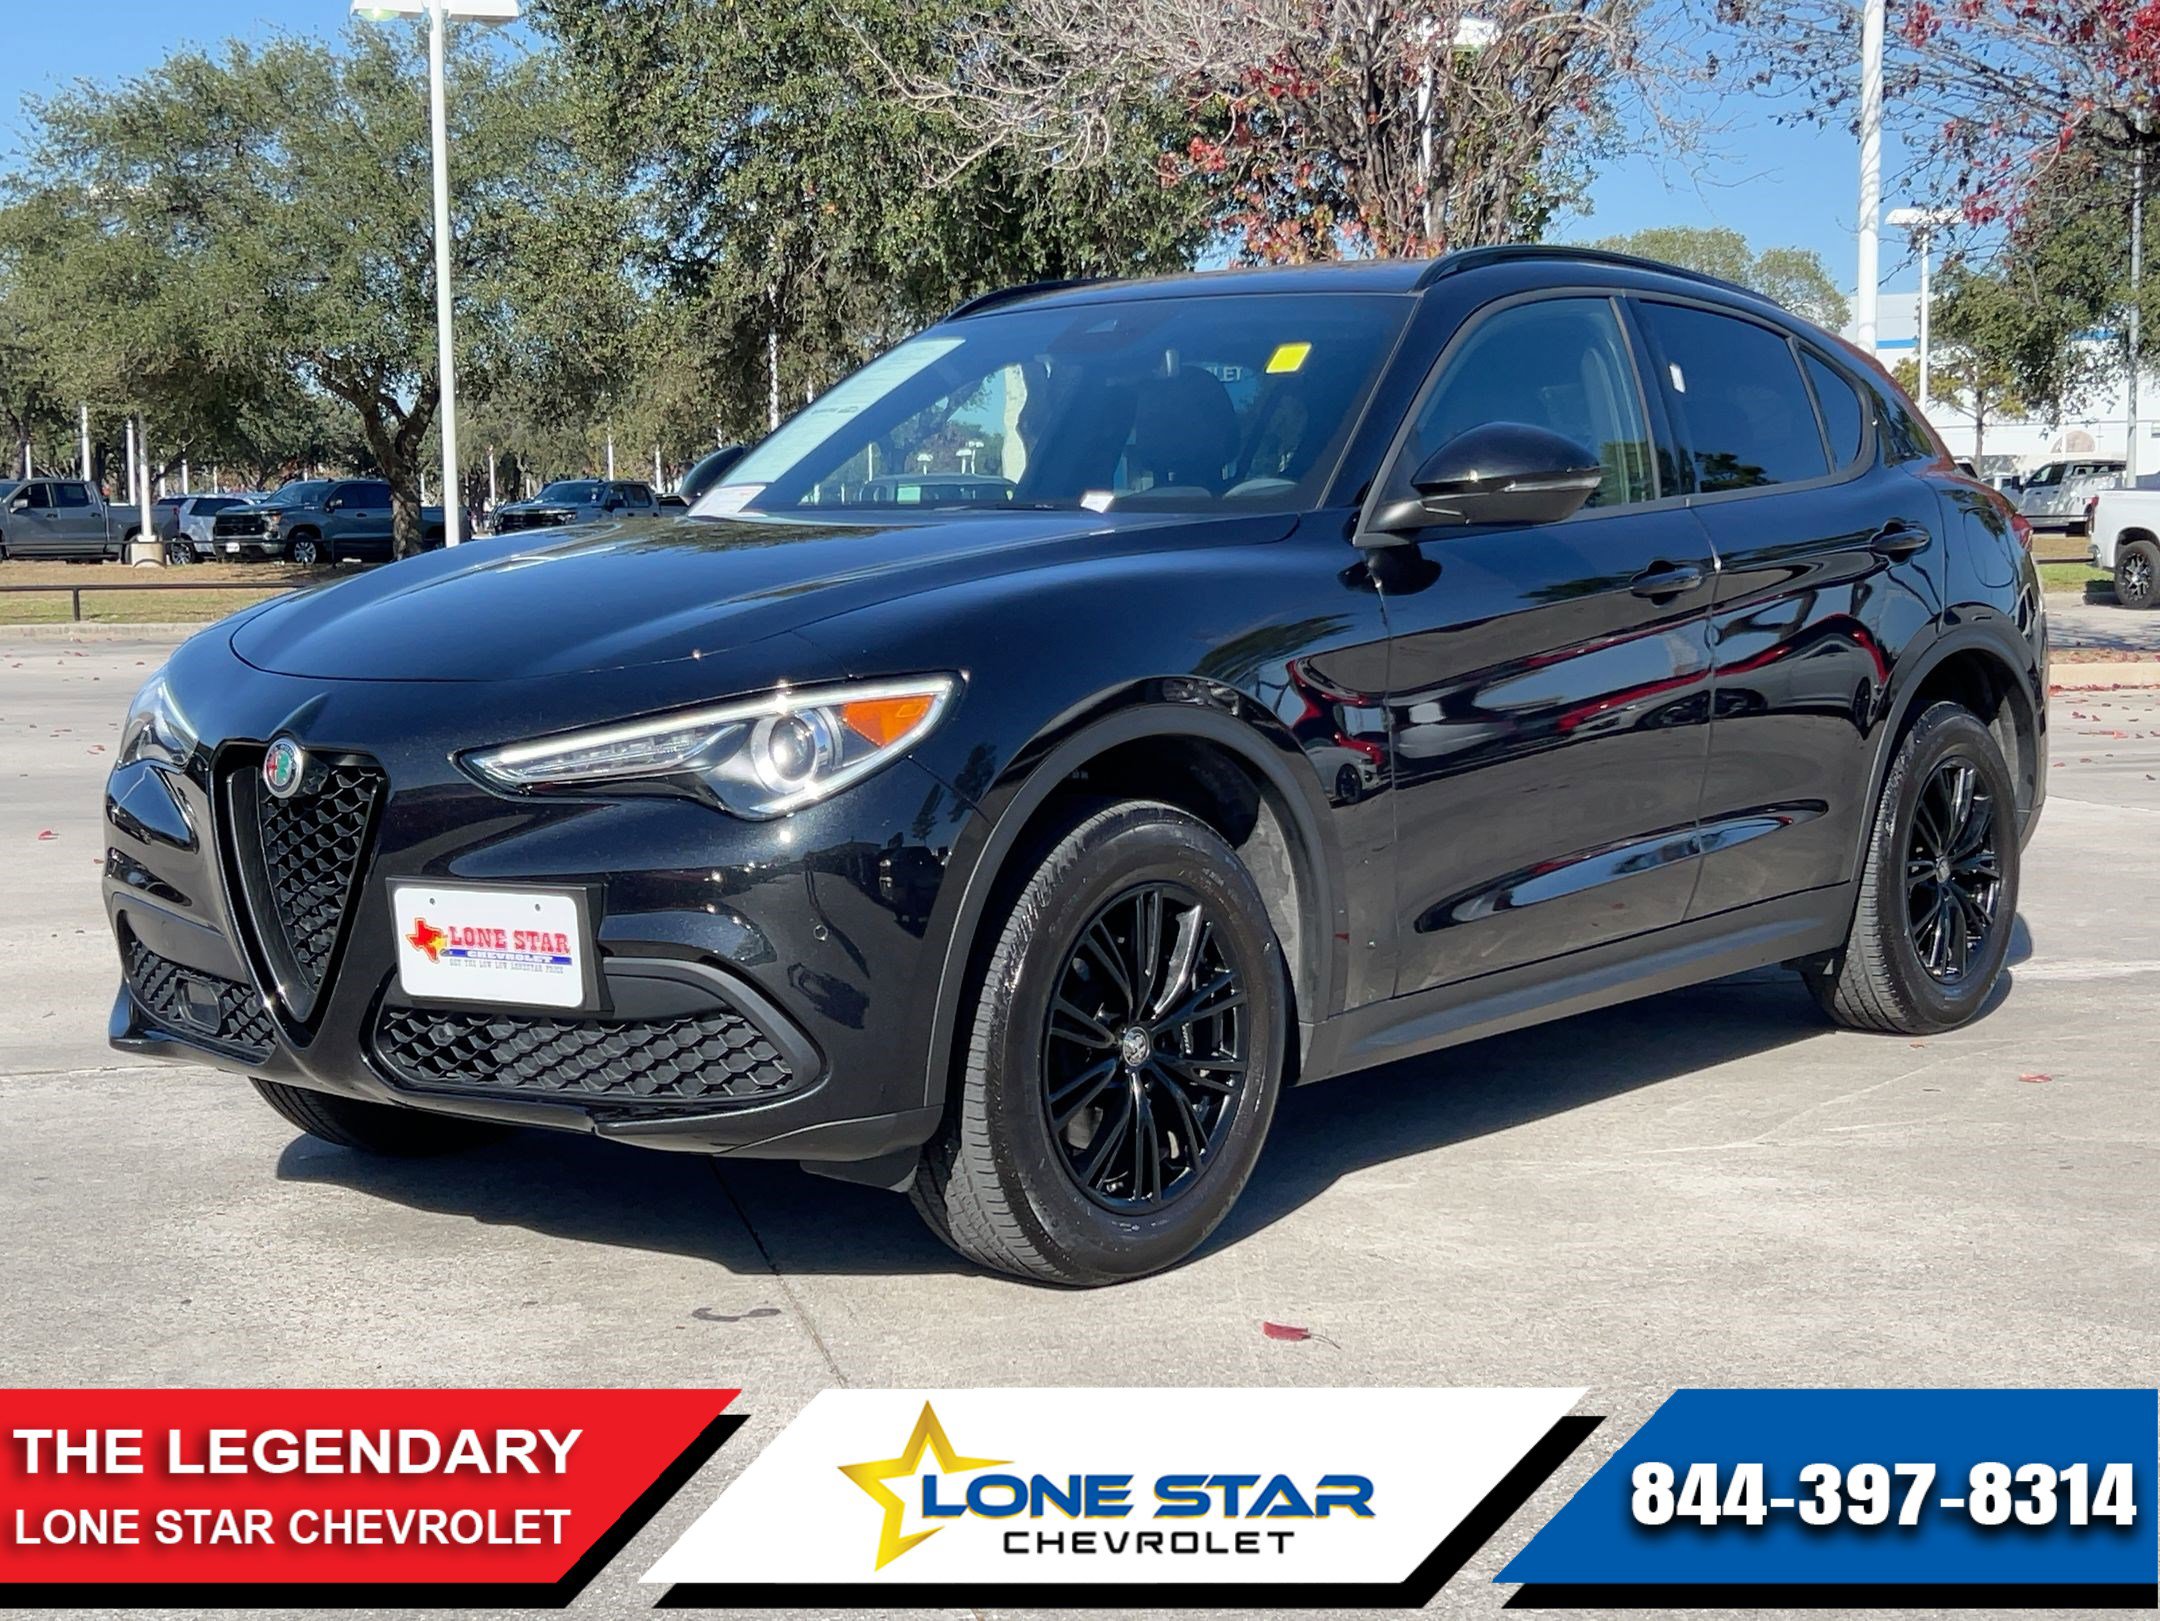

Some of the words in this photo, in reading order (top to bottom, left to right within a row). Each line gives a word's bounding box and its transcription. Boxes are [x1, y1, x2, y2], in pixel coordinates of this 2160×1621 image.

[448, 926, 507, 949] LONE
[513, 930, 571, 954] STAR
[466, 950, 553, 964] CHEVROLET
